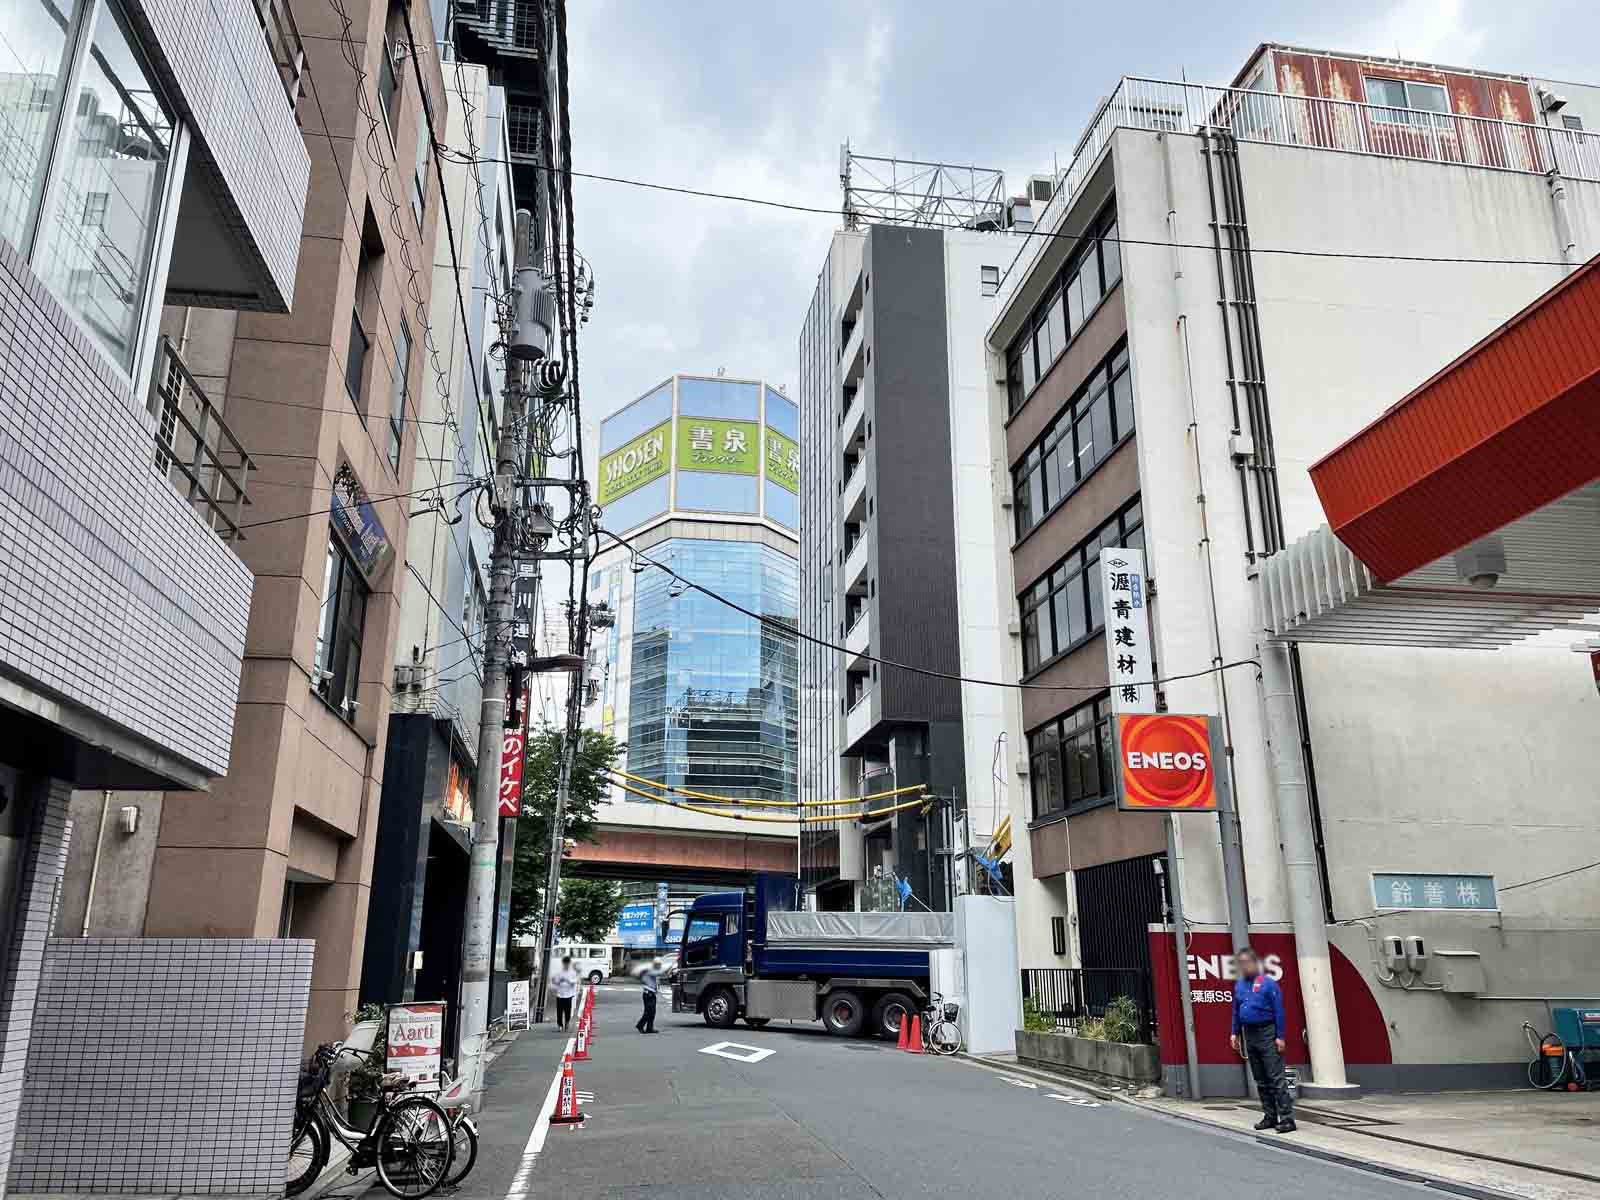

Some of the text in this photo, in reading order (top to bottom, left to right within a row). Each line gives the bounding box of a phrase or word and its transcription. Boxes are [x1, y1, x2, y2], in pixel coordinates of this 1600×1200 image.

[688, 427, 747, 453] 書泉
[1127, 752, 1206, 770] ENEOS
[1186, 954, 1283, 981] ENES
[1191, 990, 1232, 1003] 葉原SS
[392, 1023, 434, 1041] Aarti
